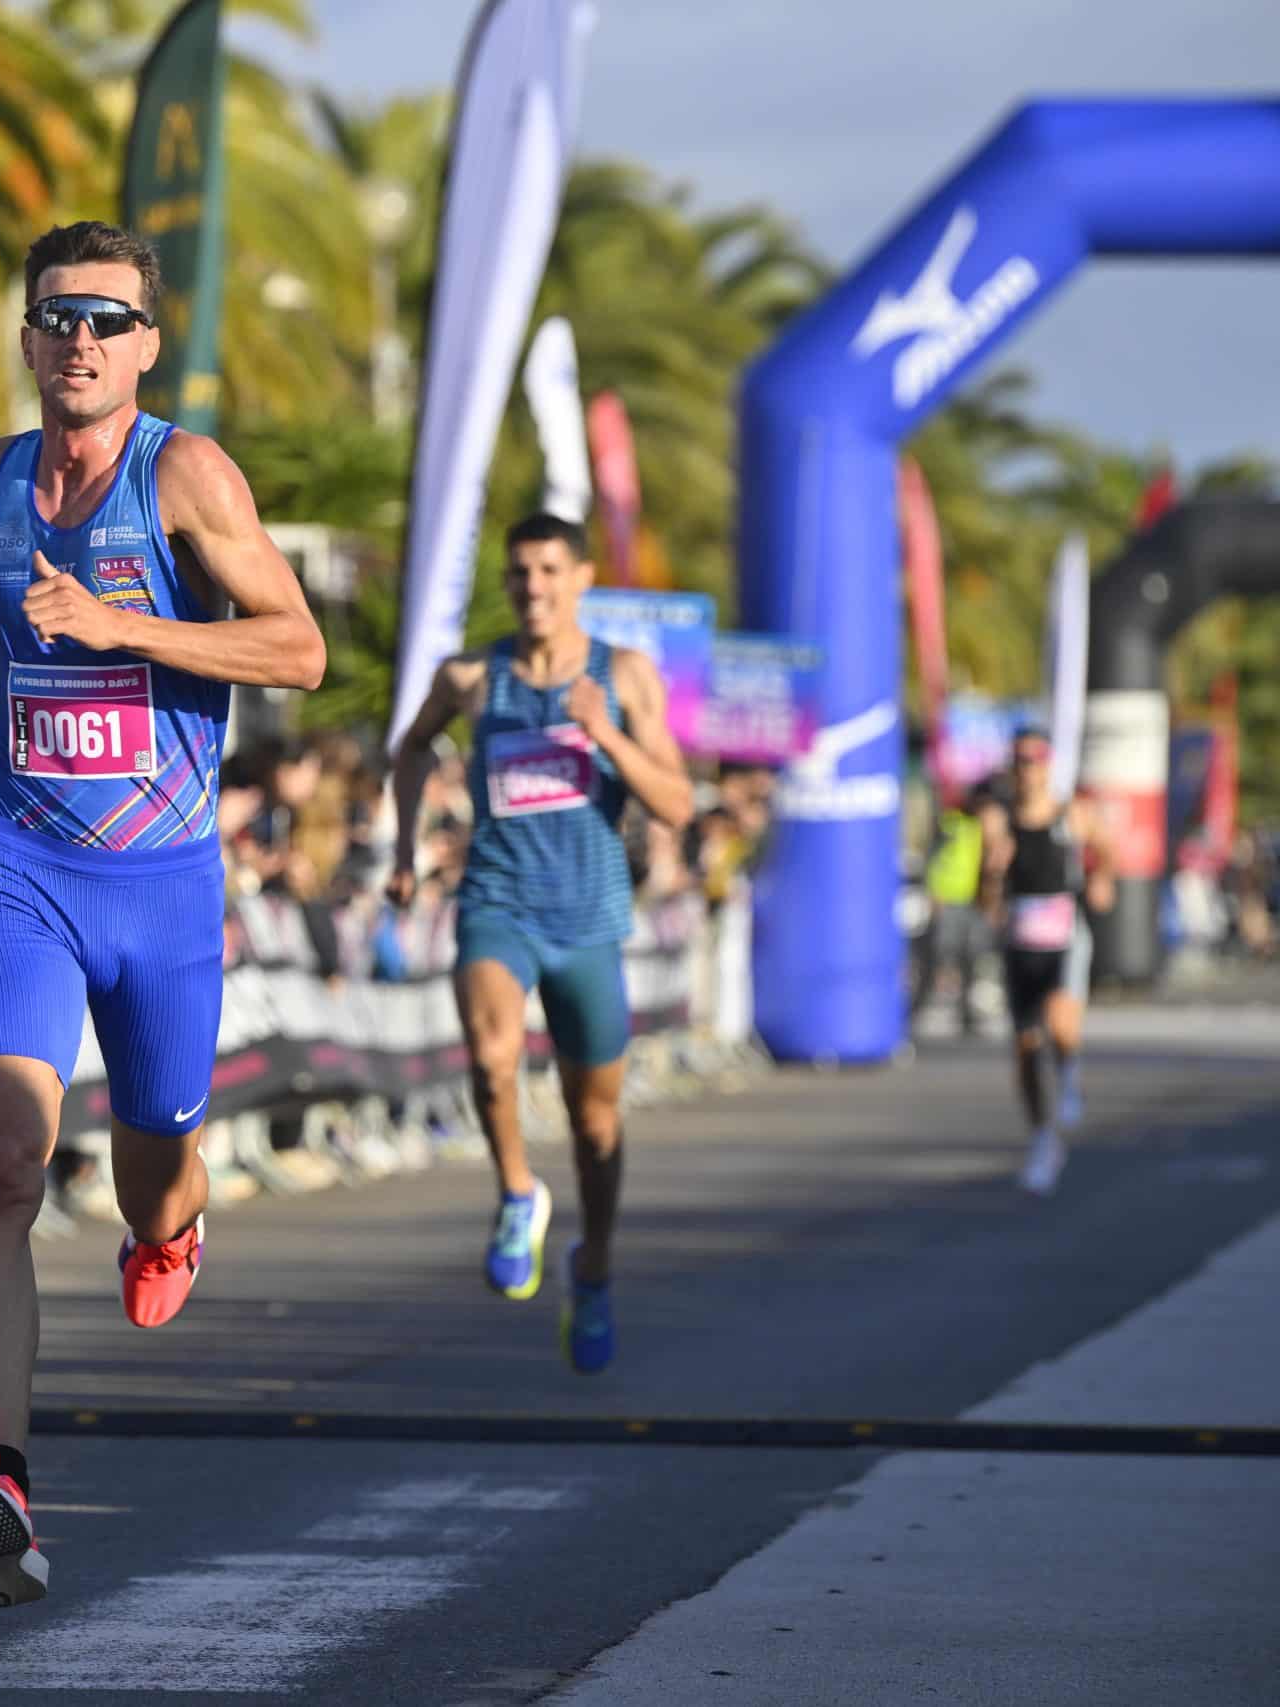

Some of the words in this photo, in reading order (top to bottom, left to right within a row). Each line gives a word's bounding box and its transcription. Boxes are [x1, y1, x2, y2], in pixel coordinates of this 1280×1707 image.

[99, 560, 142, 572] NICE
[16, 701, 27, 769] ELITE
[32, 709, 122, 759] 0061
